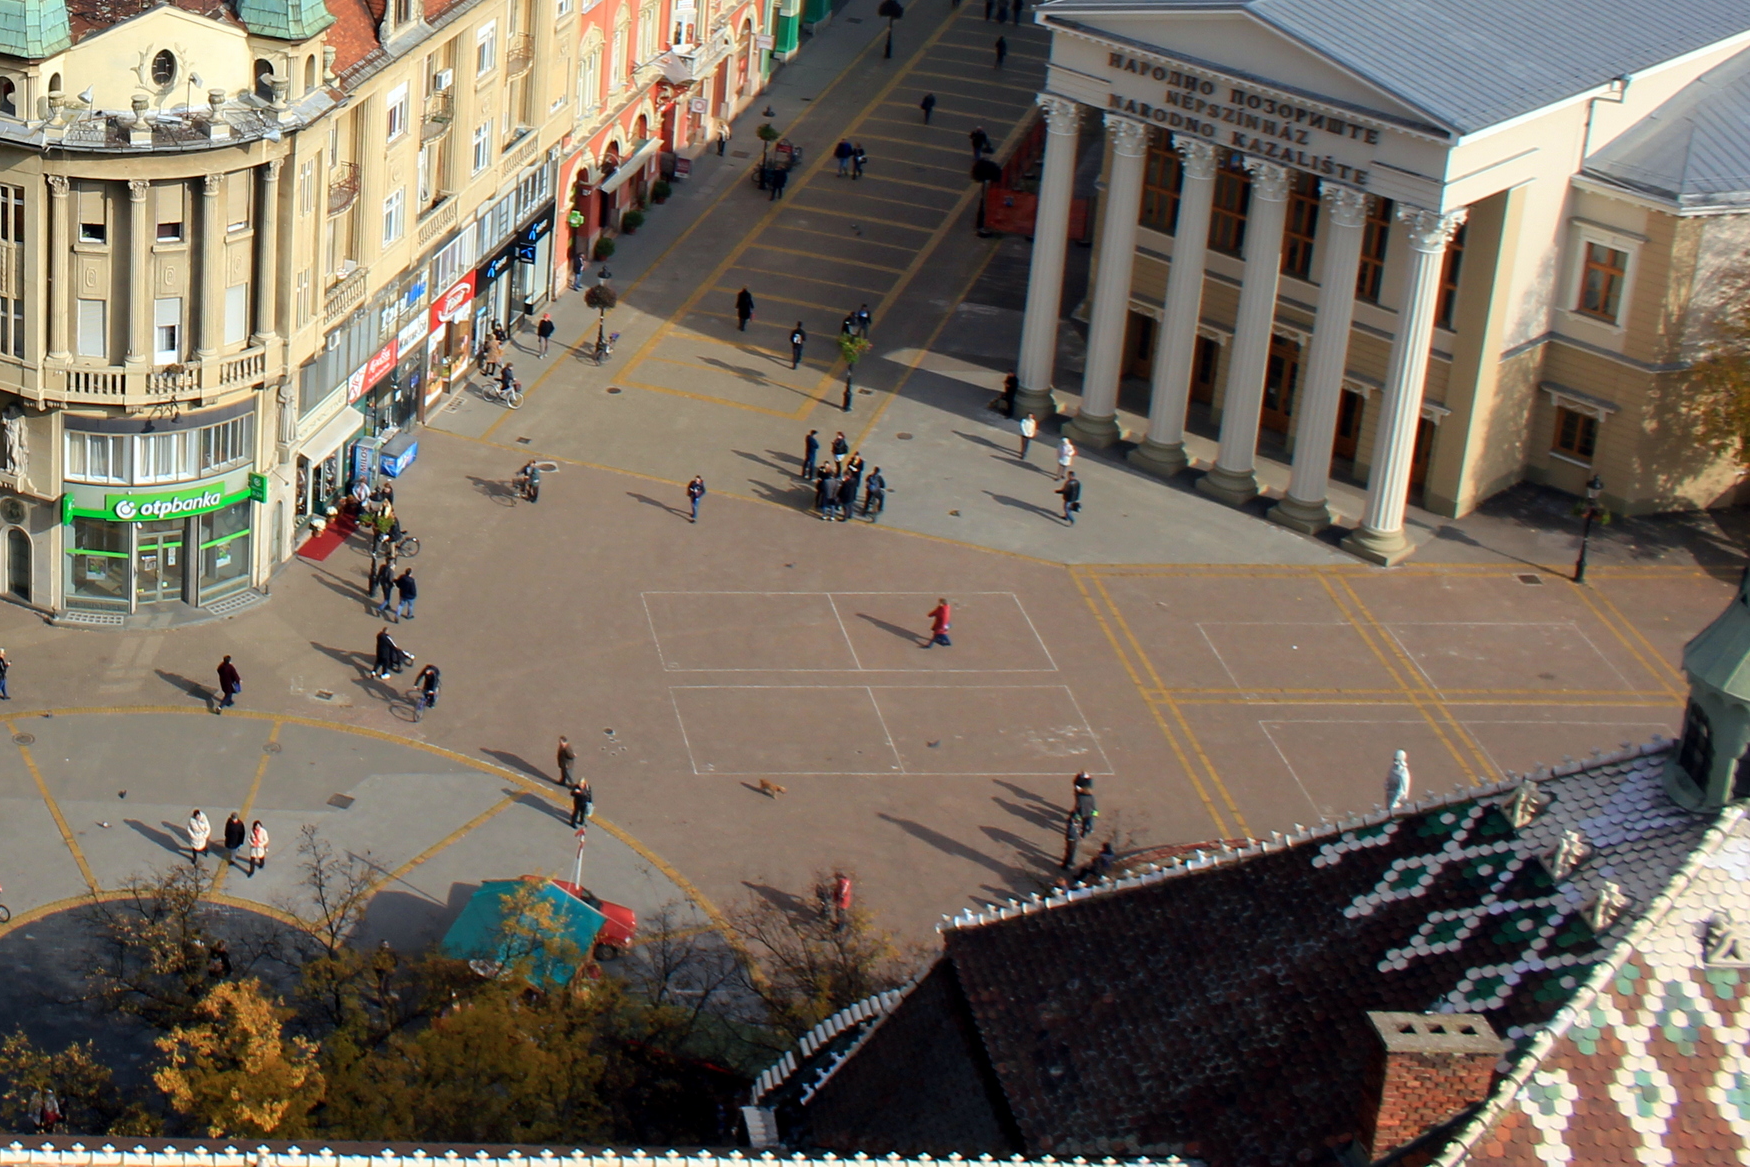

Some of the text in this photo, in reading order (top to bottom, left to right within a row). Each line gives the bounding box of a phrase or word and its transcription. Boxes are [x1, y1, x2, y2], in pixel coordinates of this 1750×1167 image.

[1108, 51, 1380, 145] НАРОДНО ПОЗОРИШТЕ
[1165, 89, 1309, 145] NÉPSZÍNHÁZ
[1108, 93, 1369, 184] NARODNO KAZALIŠTE
[140, 491, 221, 519] otpbanka
